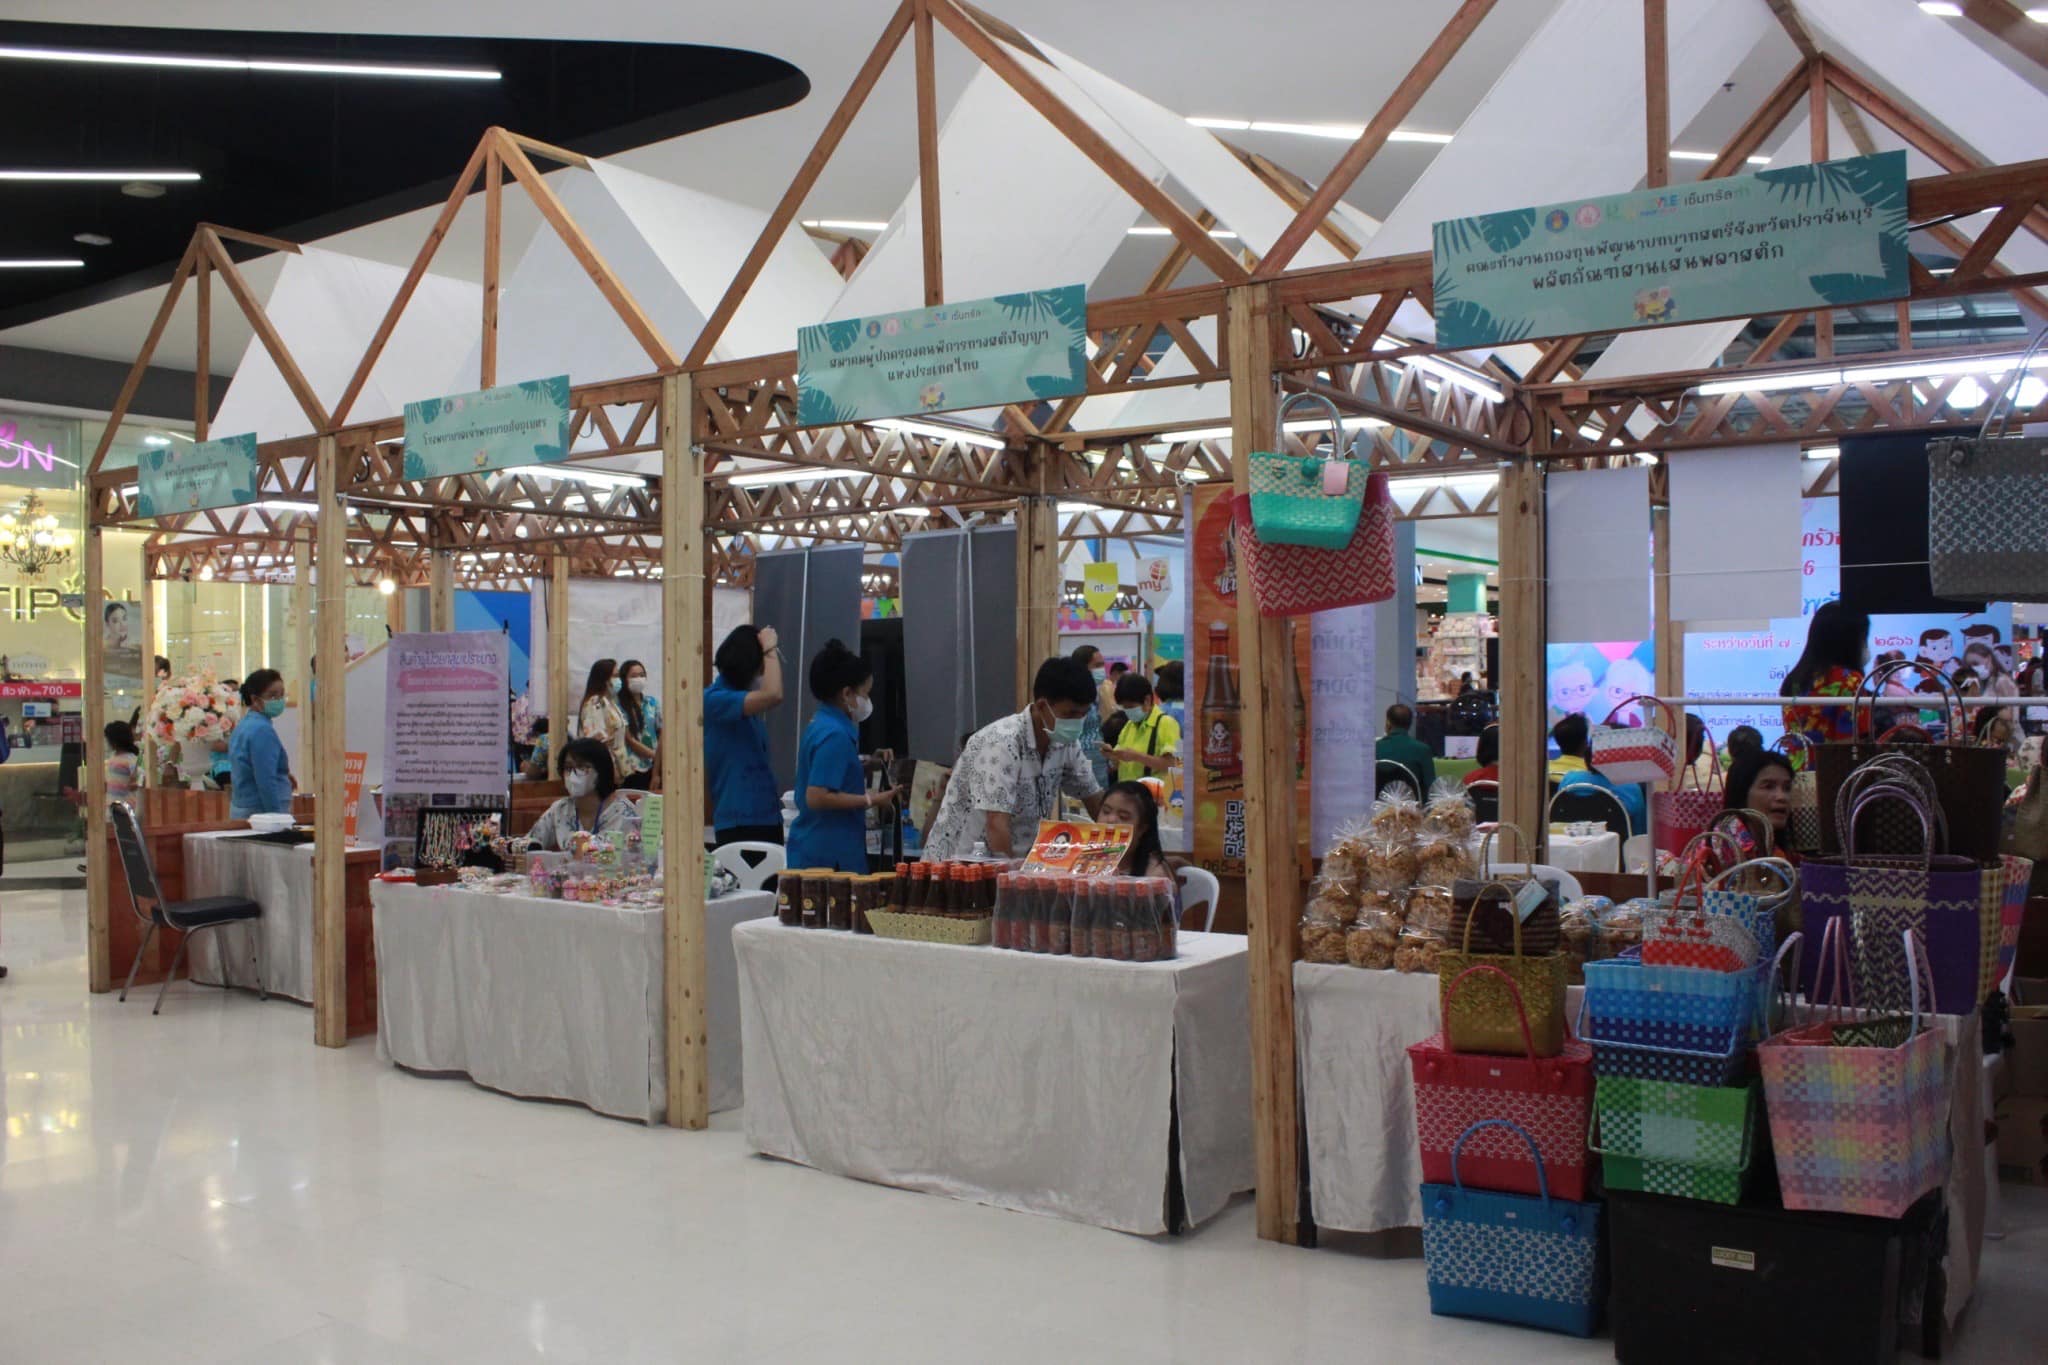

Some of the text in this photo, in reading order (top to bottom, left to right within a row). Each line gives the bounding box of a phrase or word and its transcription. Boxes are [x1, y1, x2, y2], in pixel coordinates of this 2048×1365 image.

[1533, 241, 1784, 290] ผลิตภัณฑ์สานเส้นพลาสติก
[829, 329, 1049, 369] สมาคมผู้ปกครองคนพิการทางสติปัญญา
[887, 357, 979, 382] แห่งประเทศไทย
